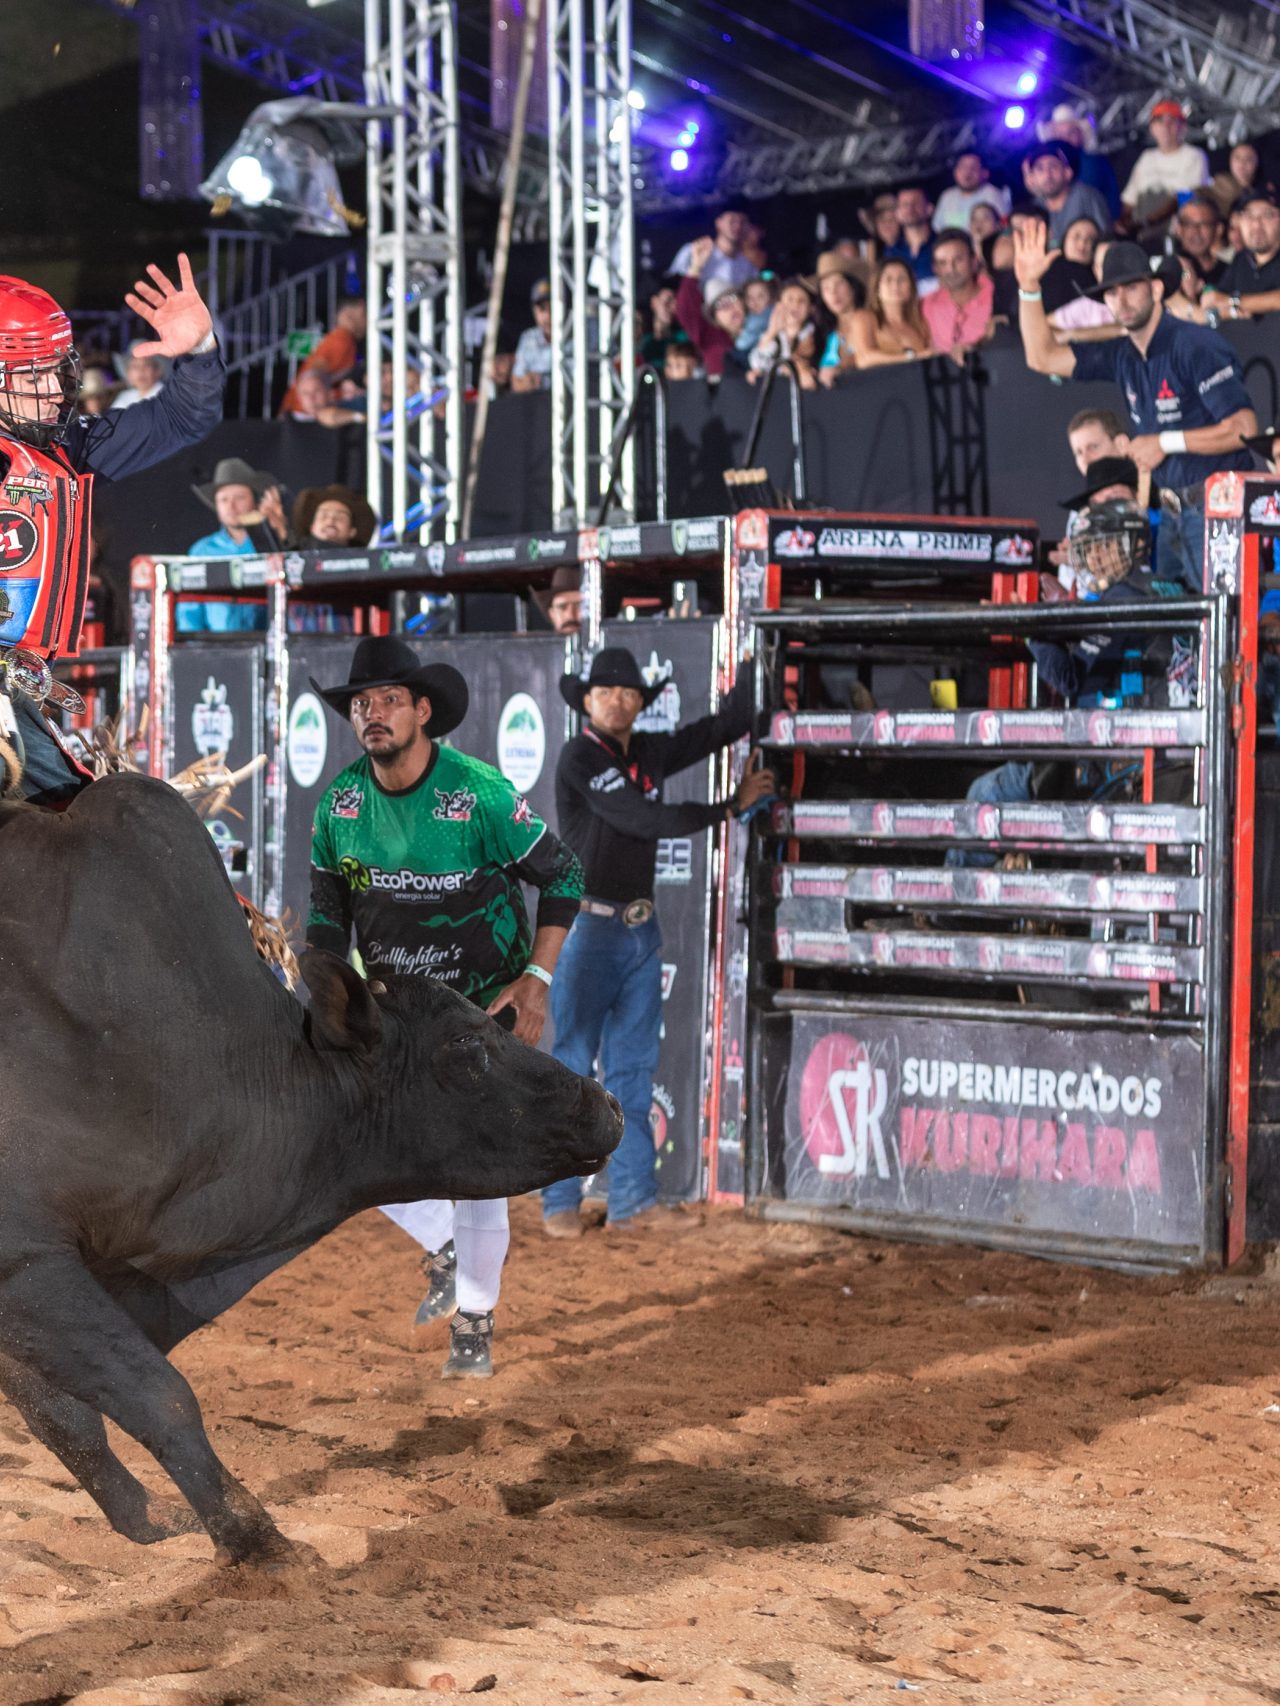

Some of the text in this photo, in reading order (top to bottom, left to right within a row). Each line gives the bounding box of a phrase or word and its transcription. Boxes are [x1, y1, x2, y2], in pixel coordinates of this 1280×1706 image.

[7, 476, 48, 489] PBR
[821, 528, 992, 552] ARENA PRIME
[370, 868, 465, 891] EcoPower
[395, 892, 441, 901] energia solar
[366, 940, 464, 974] Bullfighter's
[902, 1057, 1163, 1119] SUPERMERCADOS
